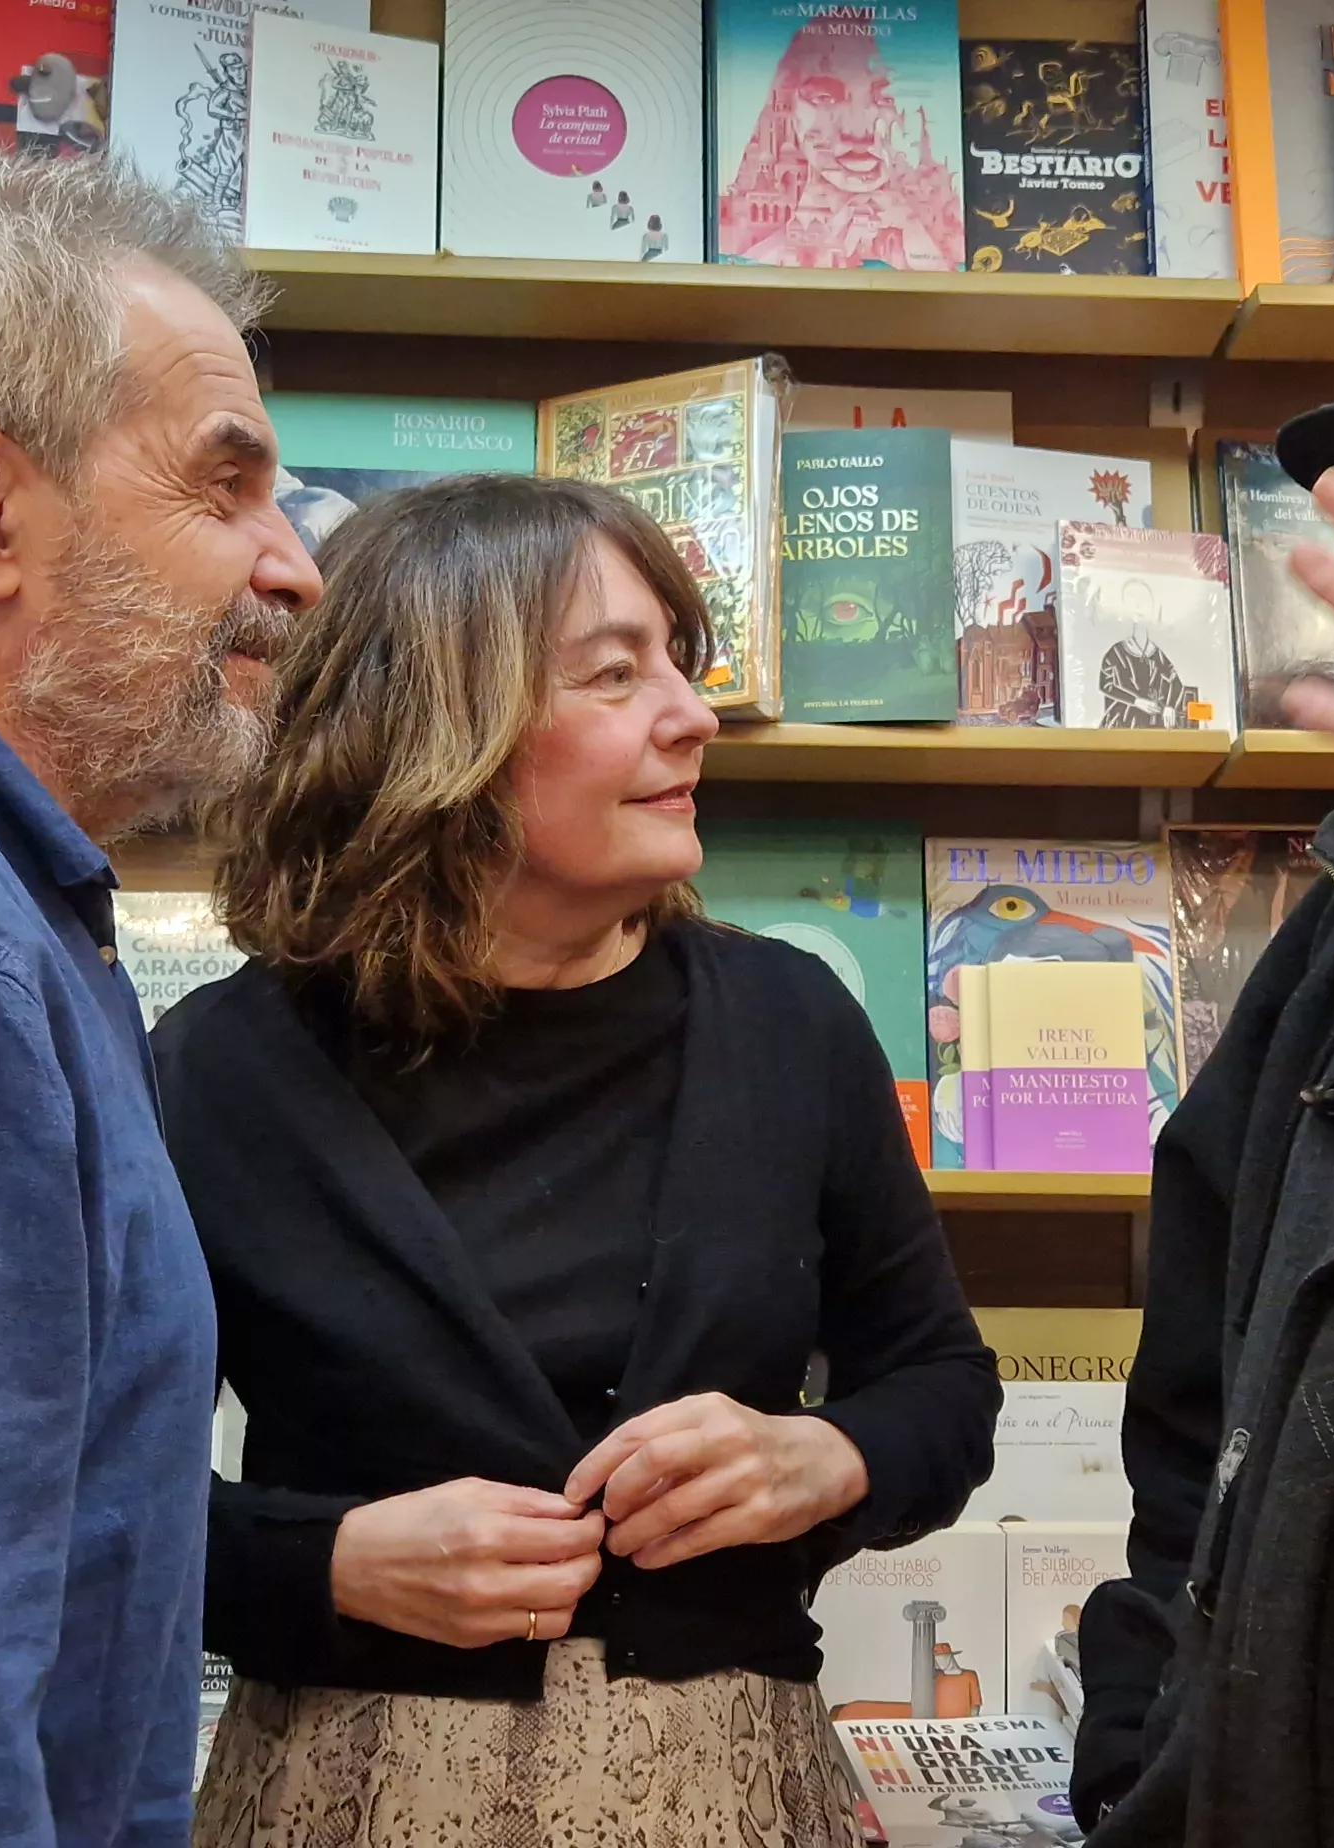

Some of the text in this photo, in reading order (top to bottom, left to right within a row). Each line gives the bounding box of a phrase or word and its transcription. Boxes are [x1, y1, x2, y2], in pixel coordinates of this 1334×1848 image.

[158, 6, 202, 22] OTROS
[797, 3, 917, 21] MARAVILLAS
[802, 23, 891, 37] DEL MUNDO
[542, 103, 608, 119] Sylvia Plath
[556, 120, 611, 134] campana
[548, 131, 603, 146] de cristal
[969, 141, 1144, 179] BESTIARIO
[1018, 177, 1106, 191] Javier Tomeo
[393, 412, 486, 433] ROSARIO
[392, 432, 513, 452] DE VELASCO
[796, 455, 884, 471] PABLO GALLO
[802, 485, 880, 510] OJOS
[965, 483, 1040, 502] CUENTOS
[967, 497, 1042, 517] DE ODESA
[780, 508, 919, 536] LENOS DE
[946, 847, 1155, 886] EL MIEDO
[1055, 889, 1104, 908] María
[133, 956, 238, 977] ARAGÓN
[1037, 1028, 1096, 1045] IRENE
[1026, 1046, 1109, 1065] VALLEJO
[1008, 1073, 1128, 1090] MANIFIESTO
[1000, 1092, 1138, 1106] POR LA LECTURA
[893, 1555, 942, 1573] HABLÓ
[1022, 1557, 1096, 1572] EL SILBIDO
[824, 1572, 935, 1588] DE NOSOTROS
[1022, 1571, 1045, 1587] DEL
[847, 1718, 1048, 1737] NICOLÁS SESMA
[851, 1734, 985, 1752] NI UNA
[859, 1746, 1071, 1769] NI GRANDE
[870, 1764, 1038, 1786] NI LIBRE
[876, 1786, 896, 1794] LA
[900, 1783, 989, 1795] DICTADURA
